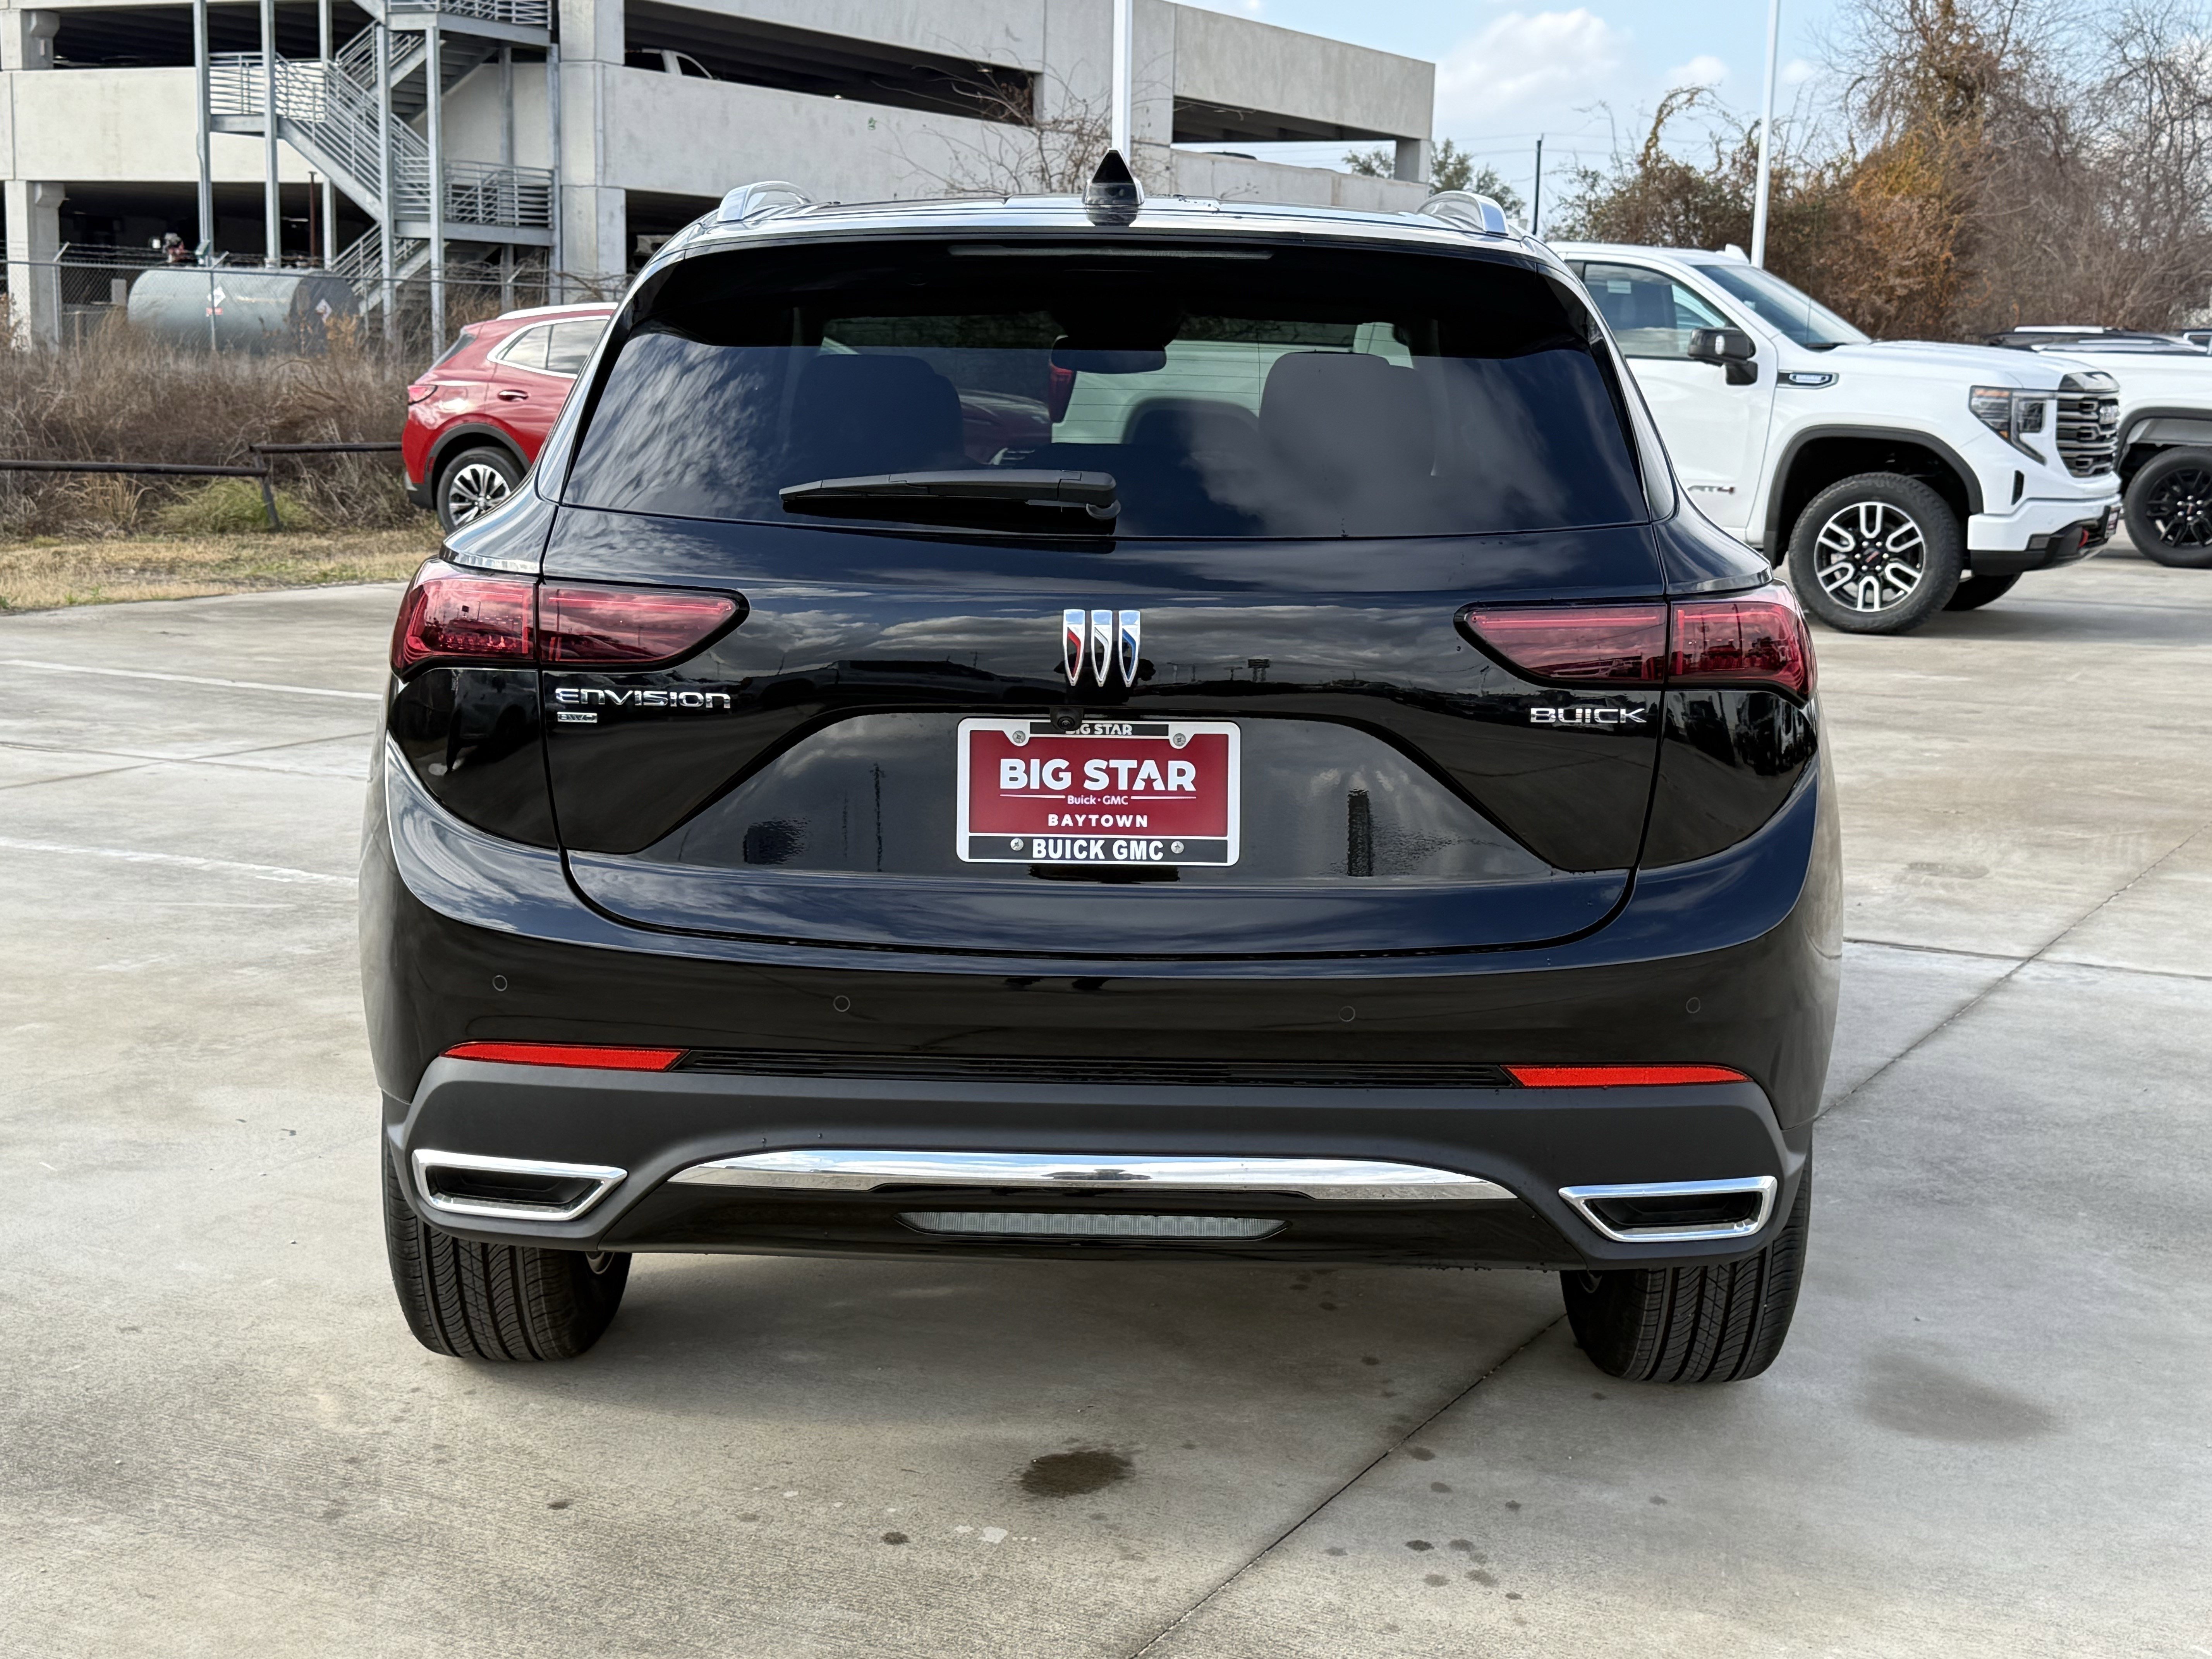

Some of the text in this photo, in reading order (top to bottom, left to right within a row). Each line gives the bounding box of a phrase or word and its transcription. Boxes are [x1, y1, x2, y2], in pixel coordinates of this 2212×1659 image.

[555, 688, 731, 709] ENVISION
[1530, 708, 1647, 723] BUICK
[1094, 724, 1132, 735] STAR
[1000, 758, 1196, 792] BIG STAR
[1048, 814, 1148, 827] BAYTOWN
[1032, 838, 1164, 860] BUICK GMC
